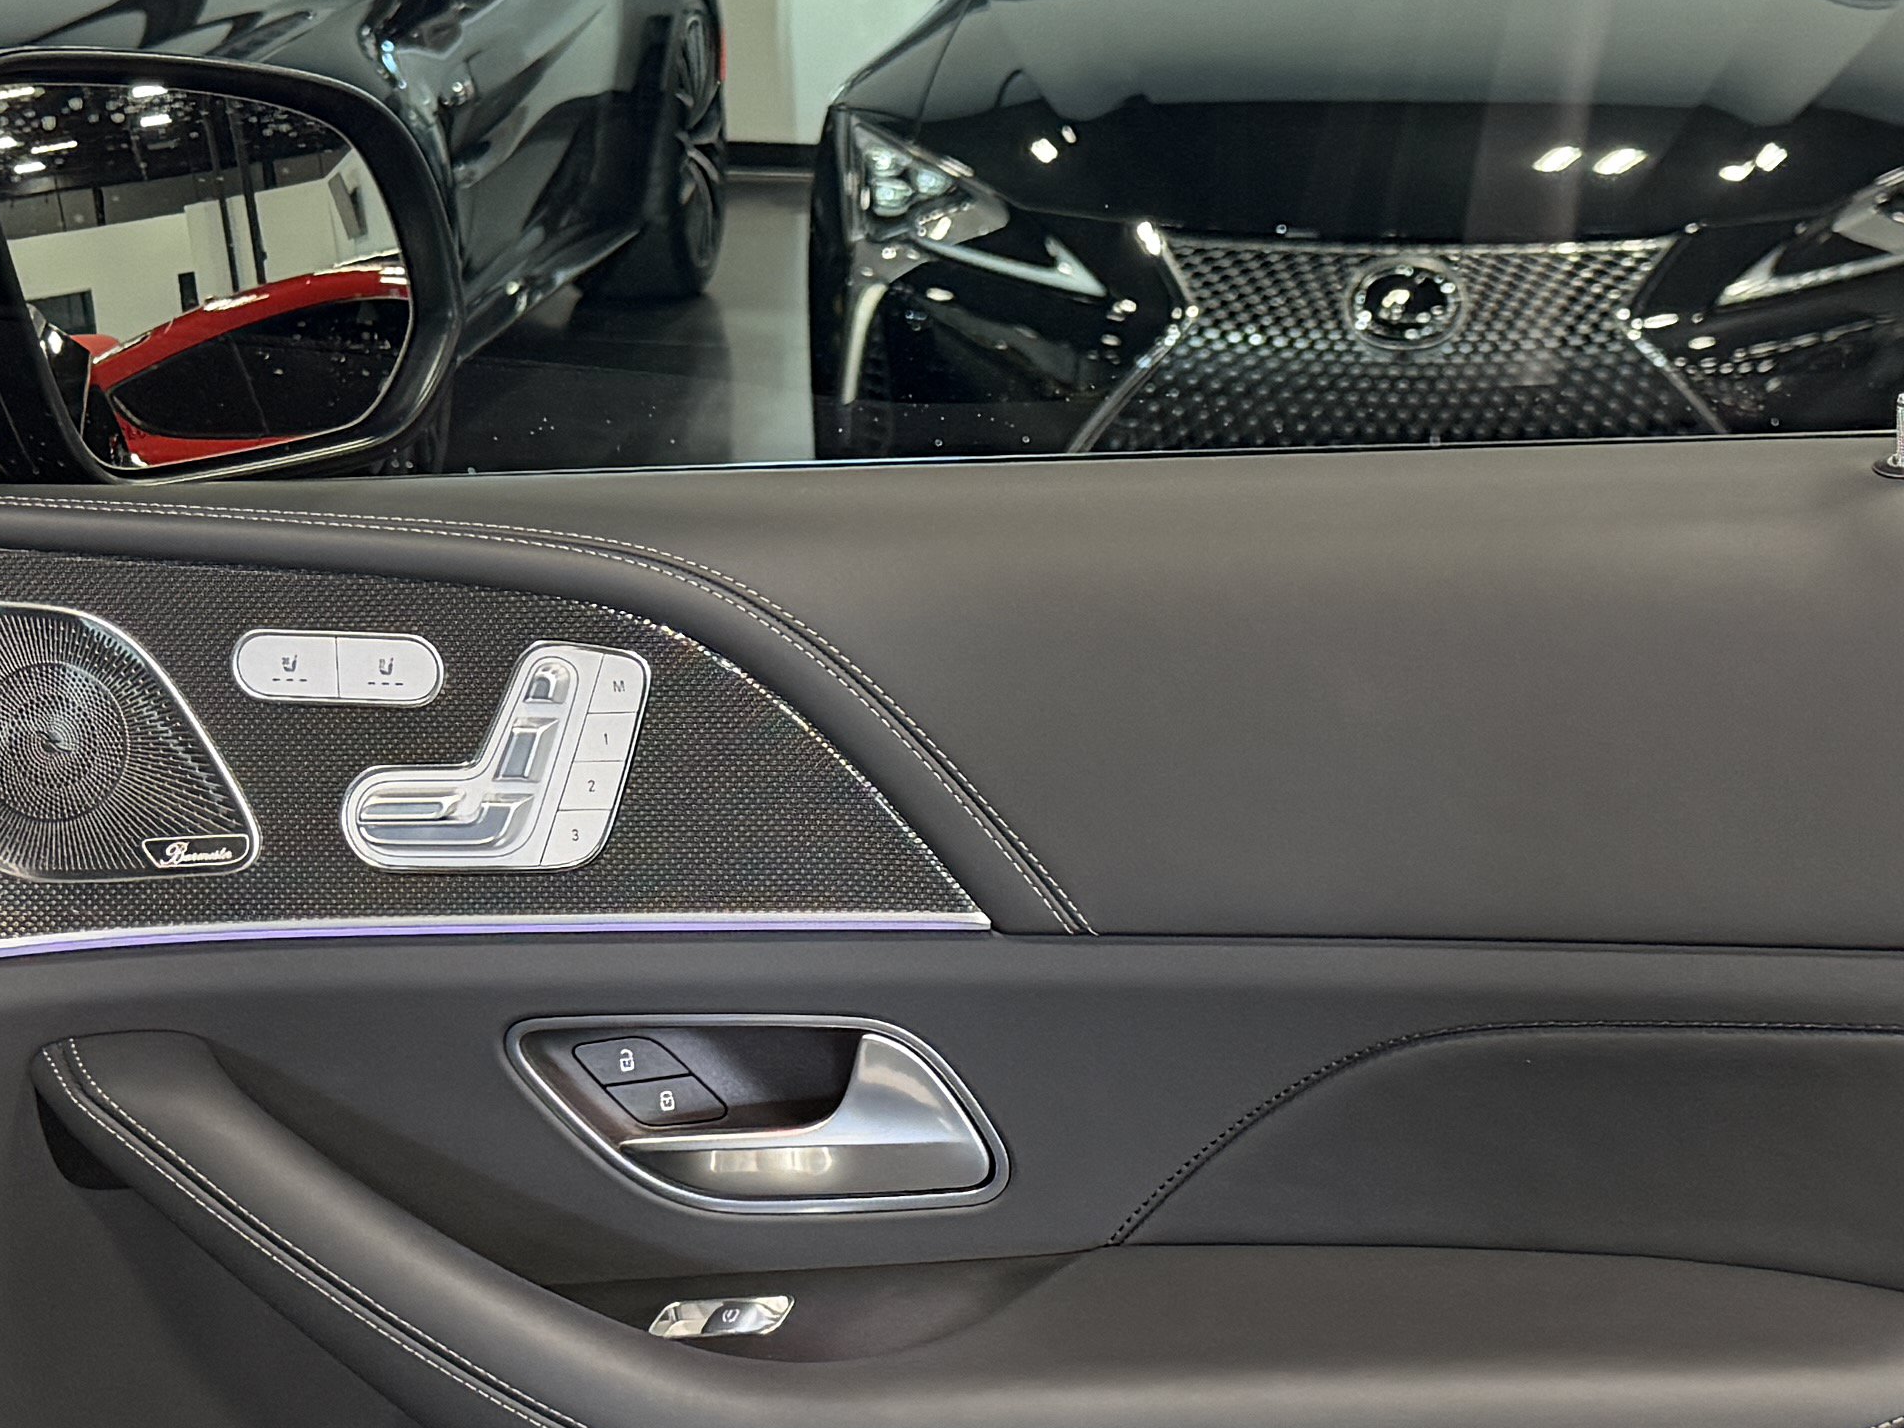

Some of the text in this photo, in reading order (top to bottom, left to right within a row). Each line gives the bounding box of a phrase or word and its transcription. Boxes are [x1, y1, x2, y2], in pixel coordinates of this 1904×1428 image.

[612, 679, 626, 693] M
[586, 779, 596, 793] 2
[571, 828, 580, 842] 3
